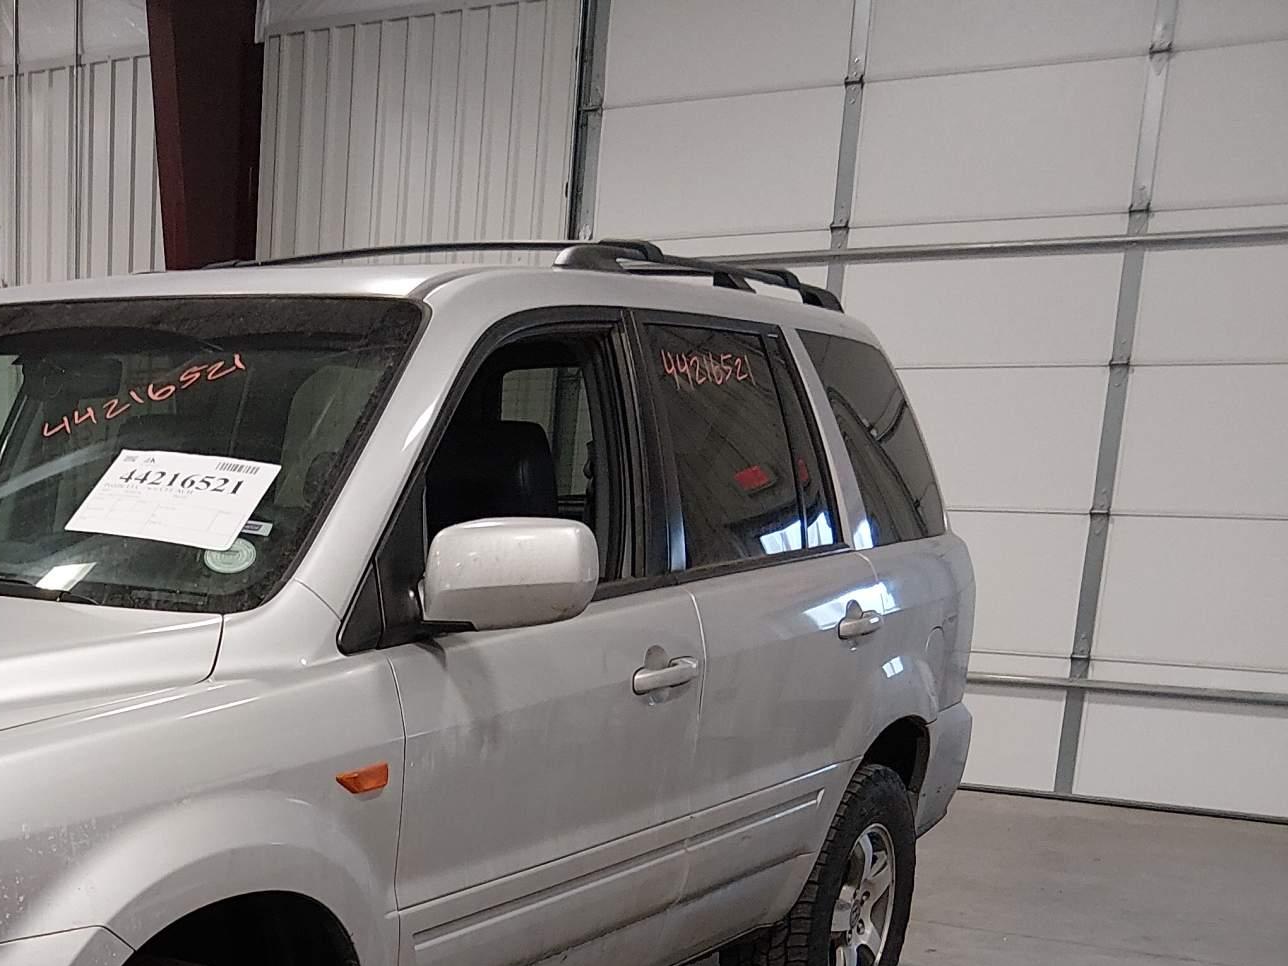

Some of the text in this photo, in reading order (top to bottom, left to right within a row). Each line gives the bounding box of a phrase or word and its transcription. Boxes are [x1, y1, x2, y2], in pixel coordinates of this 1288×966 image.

[659, 349, 758, 391] 44216521
[42, 353, 246, 437] 44216521
[119, 468, 245, 495] 44216521
